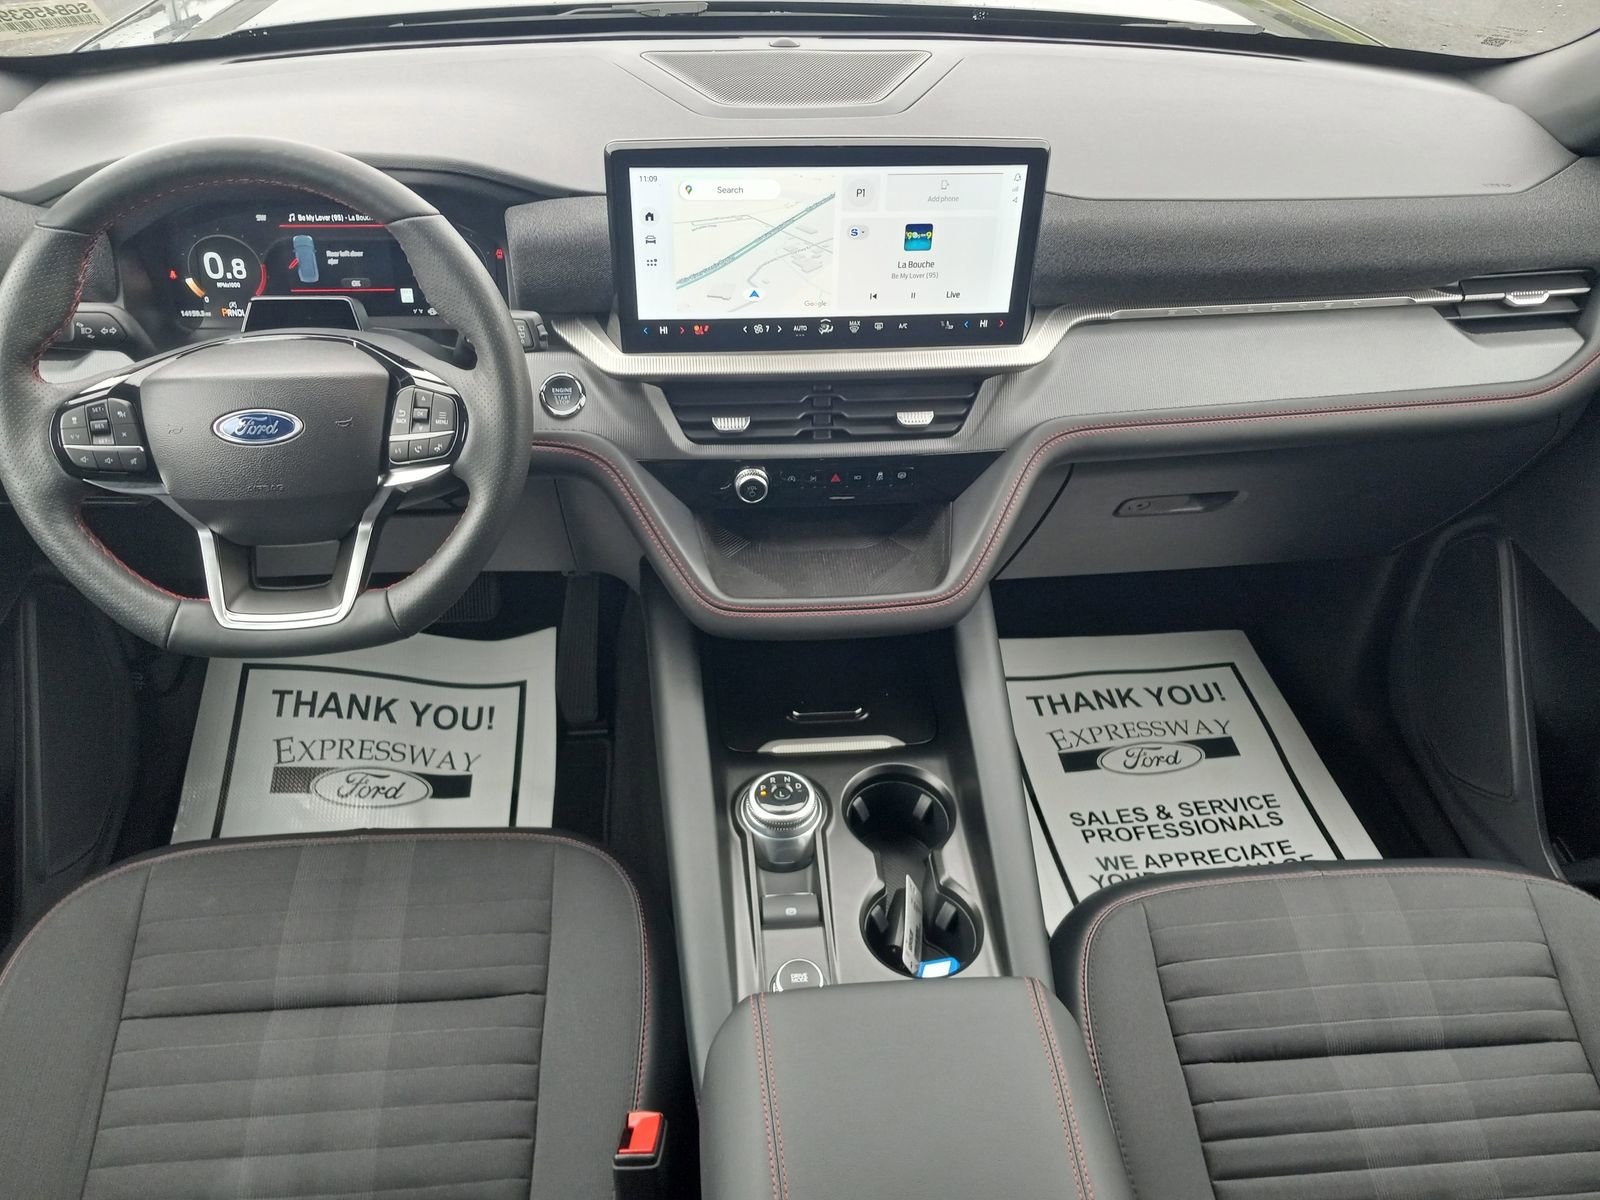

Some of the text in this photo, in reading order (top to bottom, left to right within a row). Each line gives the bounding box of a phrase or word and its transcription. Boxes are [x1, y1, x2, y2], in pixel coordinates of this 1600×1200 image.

[716, 186, 744, 194] Search
[856, 188, 866, 198] P1
[940, 195, 960, 203] phone
[203, 252, 247, 279] 0.8
[897, 260, 935, 269] La Bouche
[804, 300, 827, 308] Google
[659, 326, 668, 334] HI
[980, 320, 988, 328] HI
[235, 416, 279, 435] Ford
[271, 689, 495, 731] THANK YOU!
[1025, 681, 1227, 717] THANK YOU!
[1046, 719, 1231, 752] EXPRESSWAY
[273, 736, 481, 773] EXPRESSWAY
[1123, 746, 1182, 770] Ford
[337, 771, 406, 800] Ford
[1069, 793, 1282, 828] SALES & SERVICE
[1081, 811, 1285, 844] PROFESSIONALS
[1095, 854, 1139, 872] WE
[1145, 839, 1297, 869] APPRECIATE
